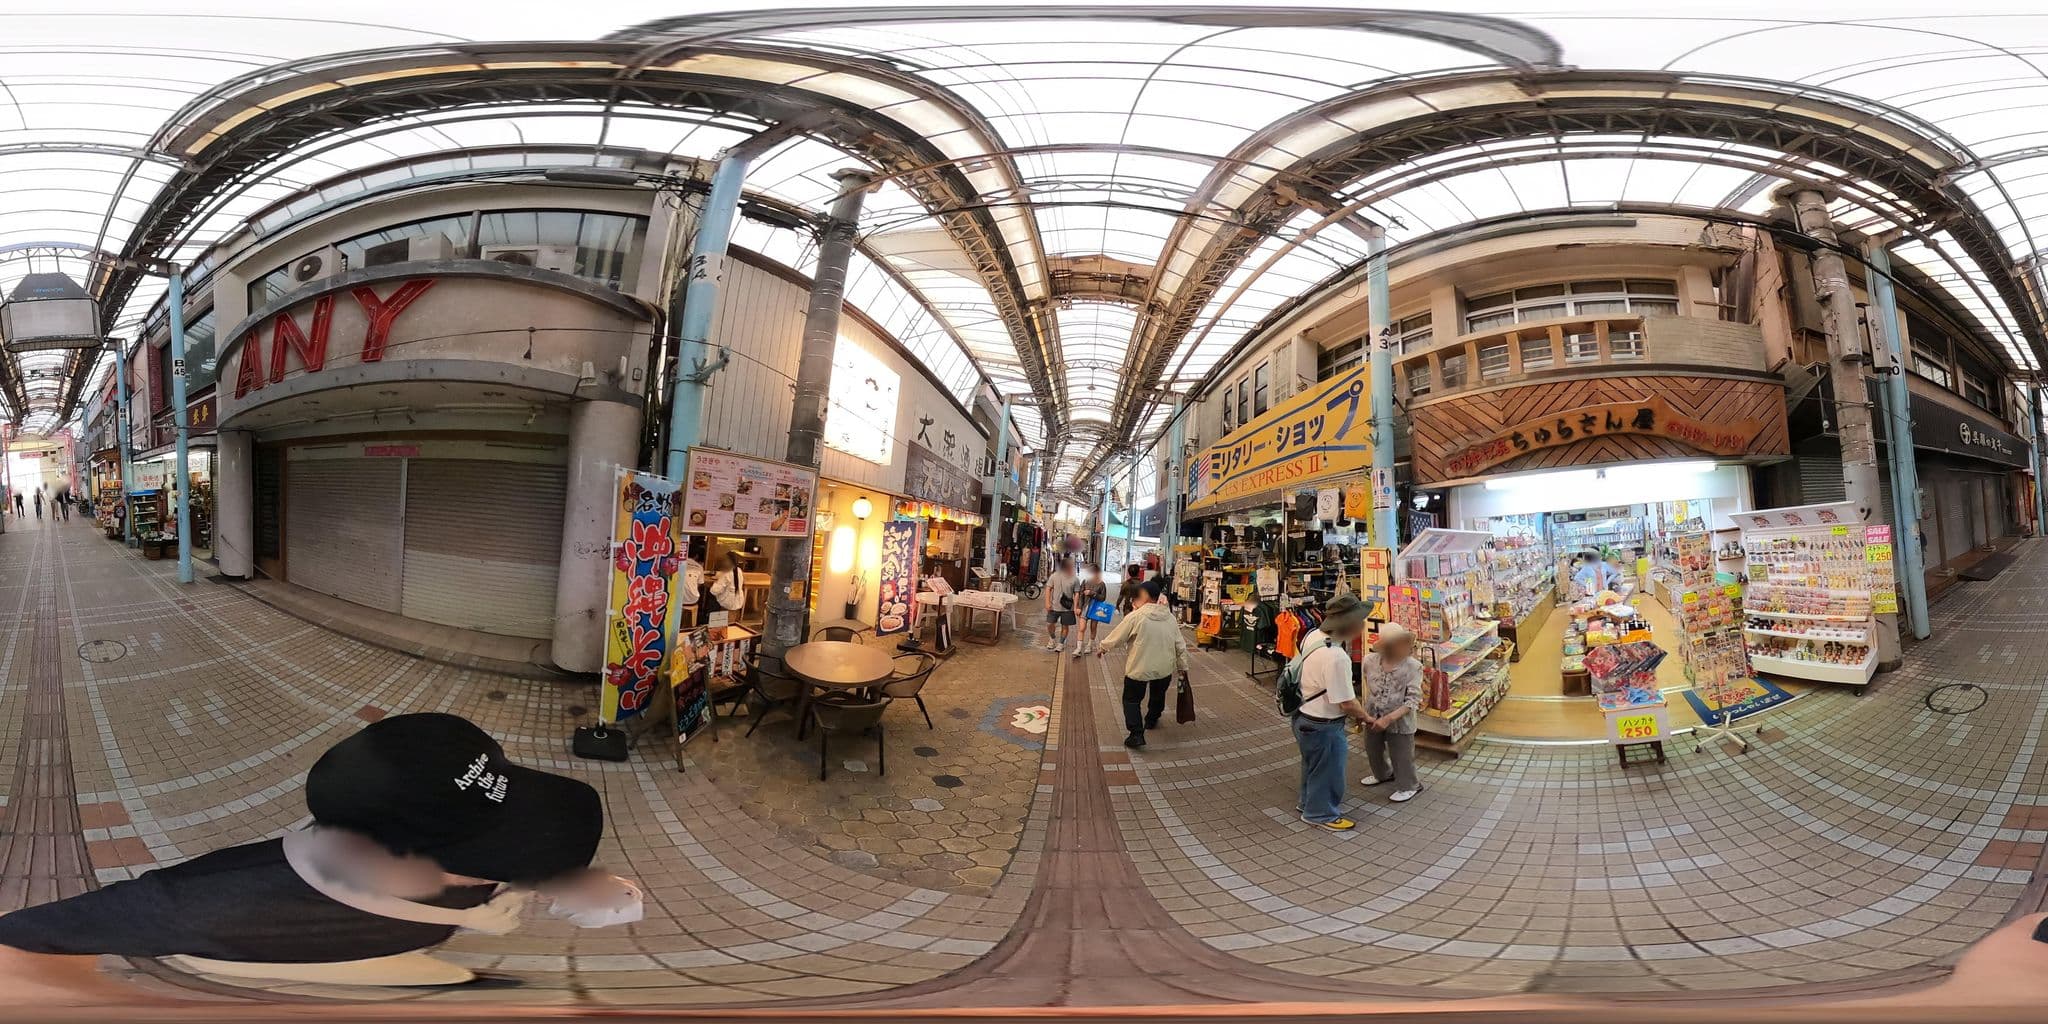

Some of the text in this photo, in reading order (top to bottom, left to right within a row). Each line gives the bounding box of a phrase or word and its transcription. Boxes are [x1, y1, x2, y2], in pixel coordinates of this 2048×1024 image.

[235, 278, 438, 400] ANY
[174, 368, 186, 376] 45
[175, 359, 184, 367] B
[1211, 379, 1364, 480] ミリタリー・ショップ
[1511, 408, 1656, 451] ちゅらさん屋
[1241, 460, 1303, 491] EXPRESS
[1867, 527, 1889, 535] SALE
[454, 753, 488, 790] Archive
[477, 772, 495, 789] the
[485, 775, 508, 802] future
